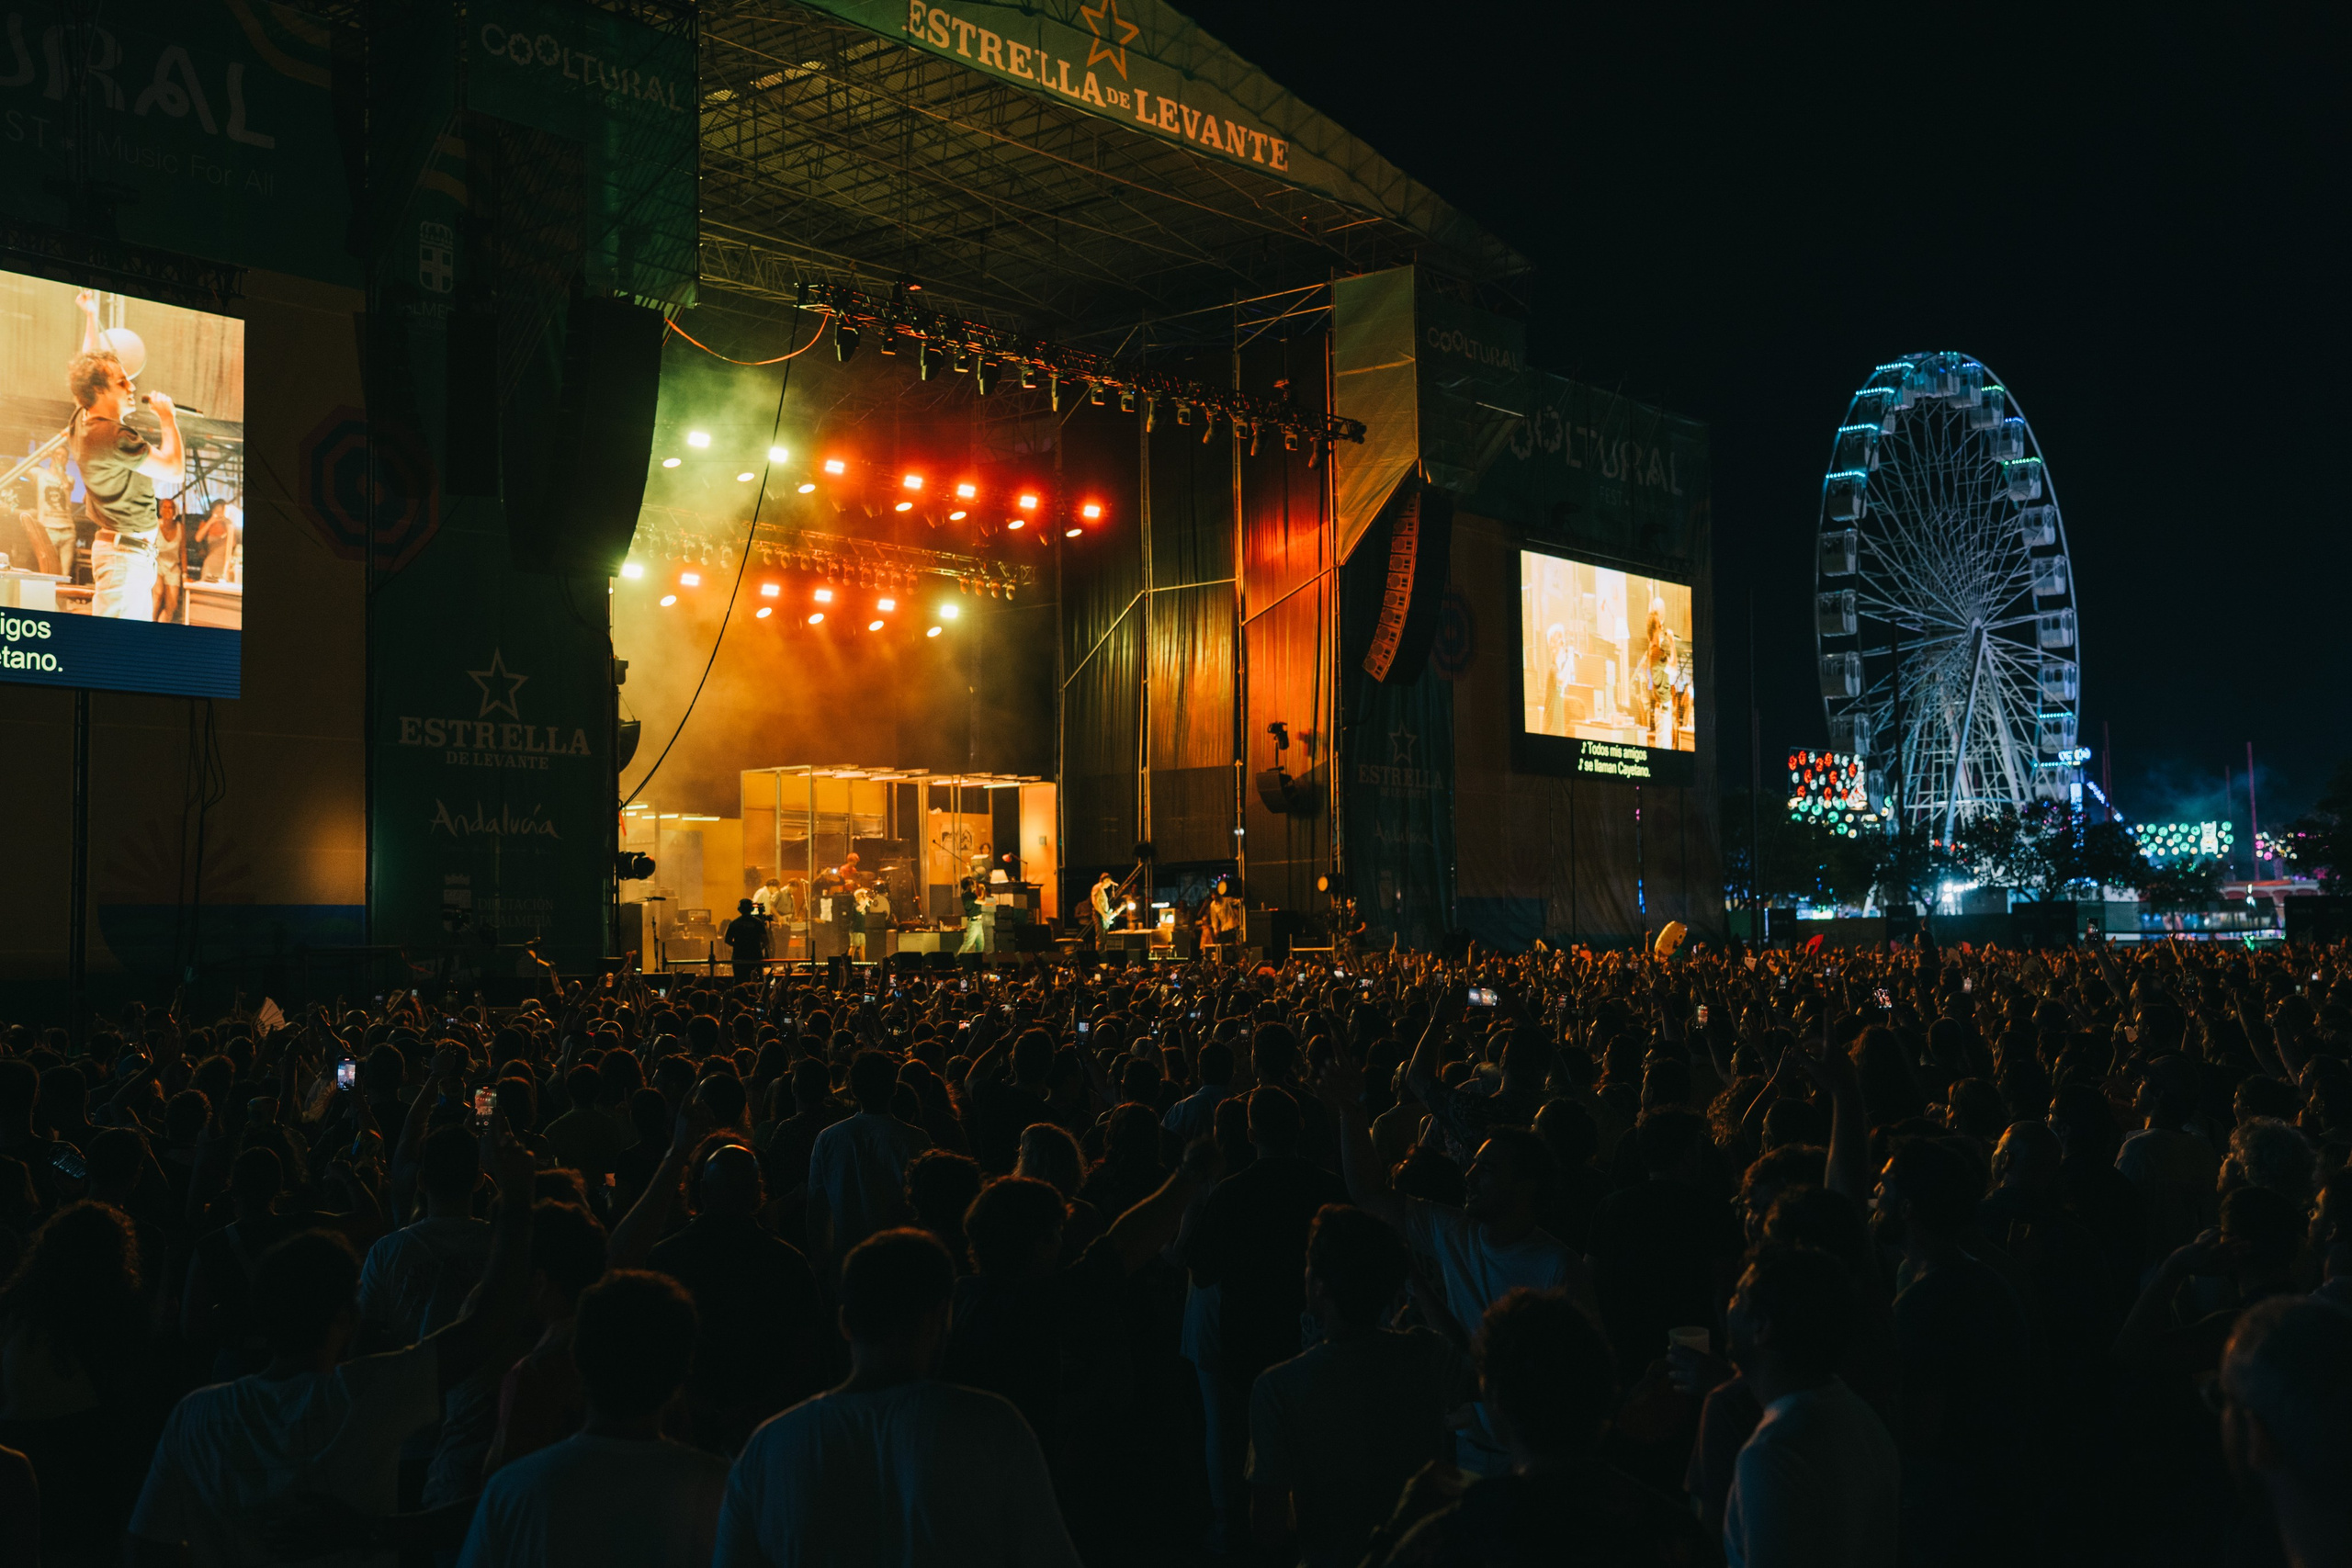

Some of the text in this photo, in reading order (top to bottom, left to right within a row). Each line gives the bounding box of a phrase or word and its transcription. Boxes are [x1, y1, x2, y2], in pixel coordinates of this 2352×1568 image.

[481, 23, 685, 114] COOLTURAL
[901, 0, 1289, 173] ESTRELLA DE LEVANTE
[96, 130, 178, 175] Music
[191, 154, 232, 186] For
[244, 169, 274, 197] All
[1427, 326, 1520, 373] COOLTURAL
[399, 716, 592, 756] ESTRELLA
[1588, 741, 1647, 763] Todos mis amigos
[446, 750, 549, 770] DE LEVANTE
[1357, 763, 1445, 790] ESTRELLA
[1584, 759, 1652, 779] se llaman Cayetano.
[429, 797, 563, 840] Andalucía
